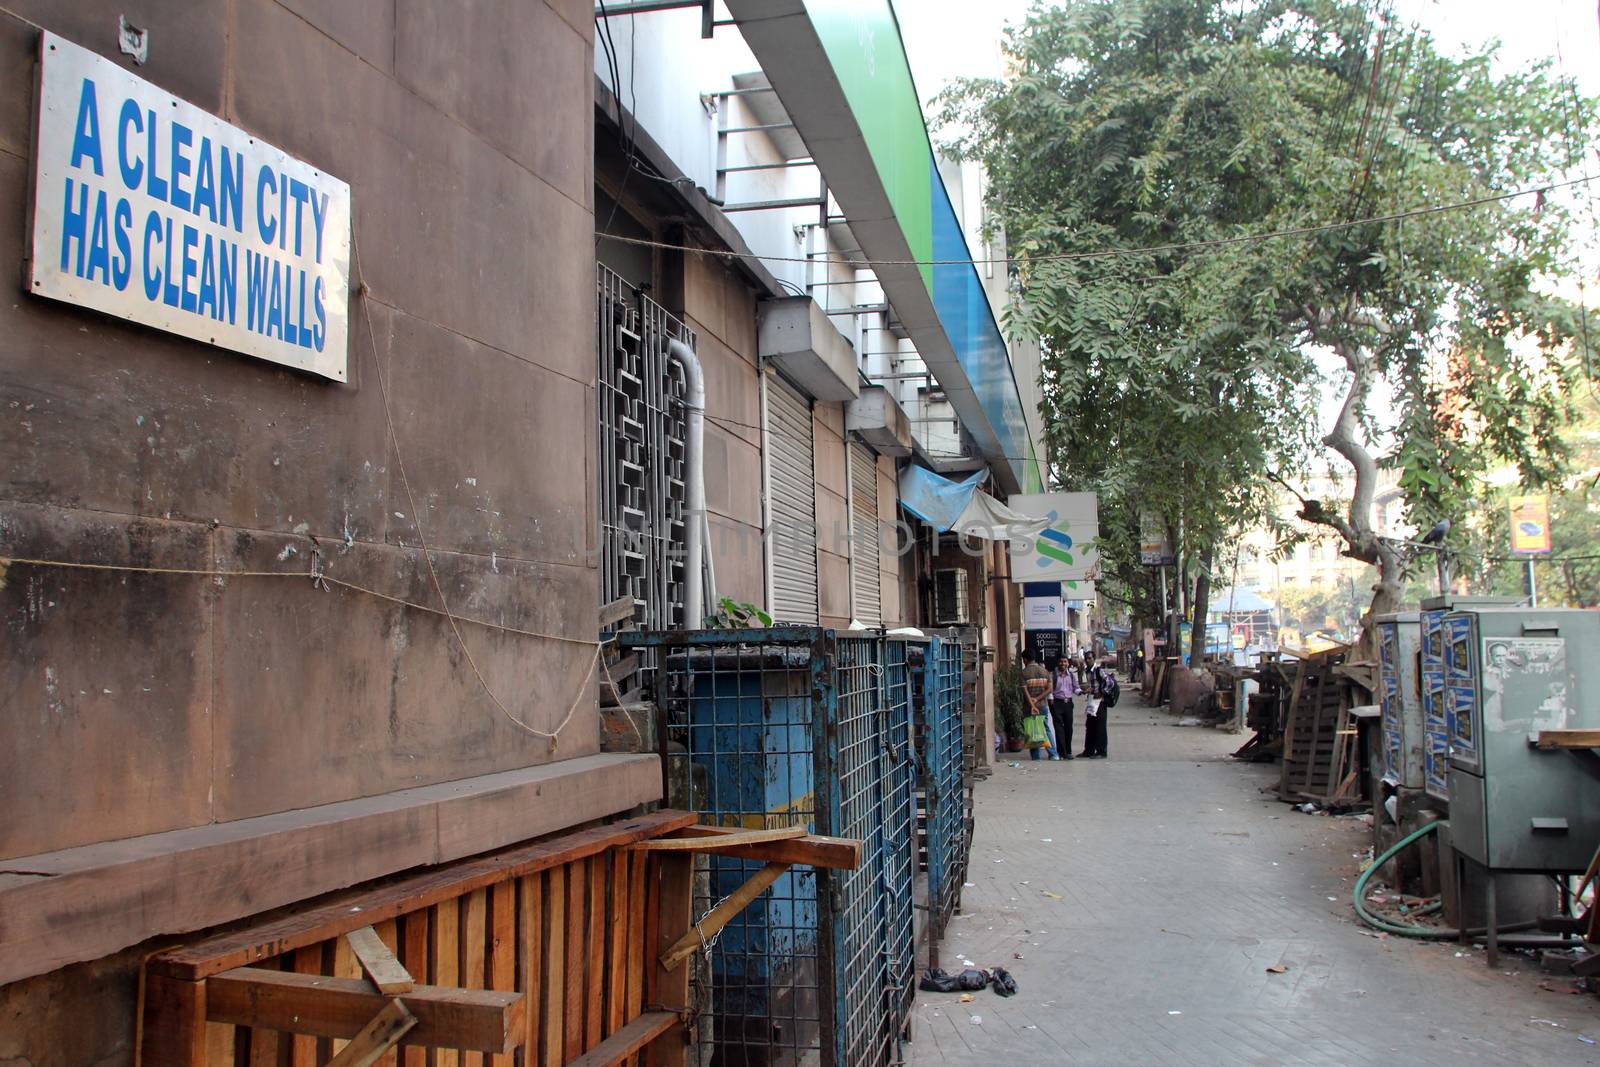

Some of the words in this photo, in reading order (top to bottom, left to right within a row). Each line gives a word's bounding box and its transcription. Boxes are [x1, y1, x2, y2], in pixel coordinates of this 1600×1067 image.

[71, 78, 104, 177] A
[118, 98, 244, 233] CLEAN
[256, 165, 329, 265] CITY
[60, 177, 132, 292] HAS
[143, 210, 237, 326] CLEAN
[246, 248, 327, 353] WALLS
[1036, 639, 1045, 647] 10
